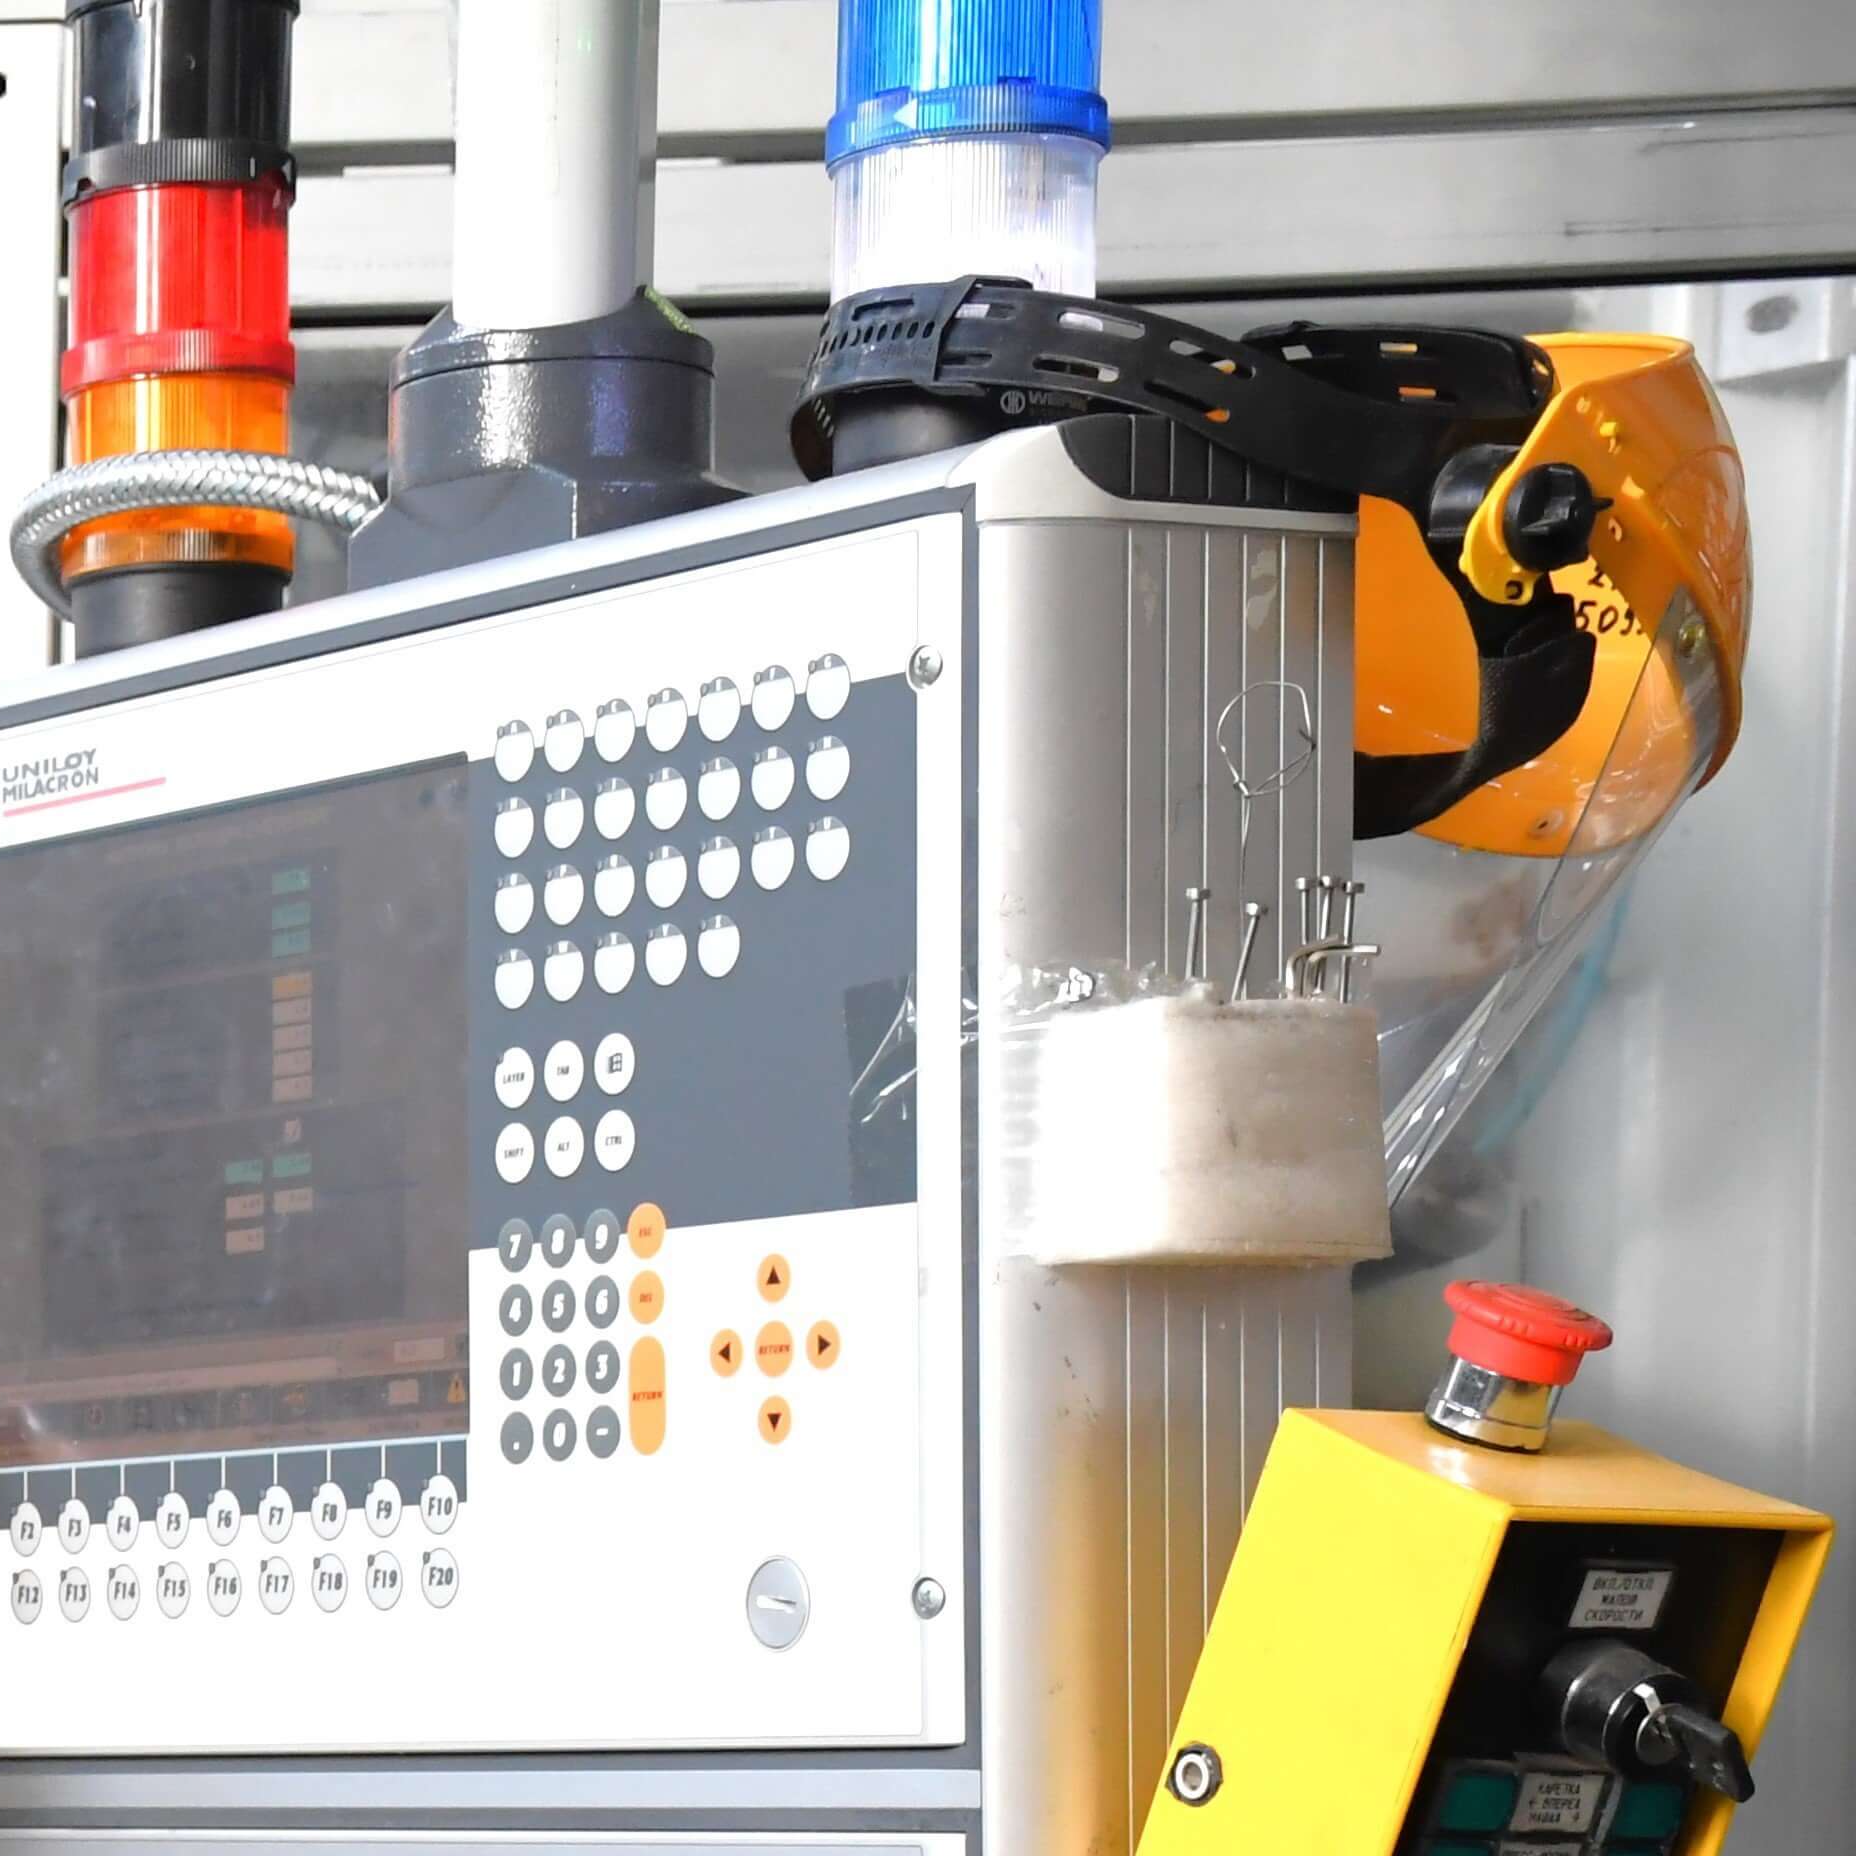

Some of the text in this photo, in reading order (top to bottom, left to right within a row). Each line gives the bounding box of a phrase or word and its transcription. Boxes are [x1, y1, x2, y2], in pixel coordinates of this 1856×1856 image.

[2, 748, 97, 783] UNILOY
[2, 766, 99, 803] MILACRON
[509, 1233, 522, 1259] 7
[551, 1228, 565, 1254] 8
[595, 1224, 608, 1249] 9
[508, 1298, 521, 1322] 4
[552, 1293, 565, 1319] 5
[595, 1289, 608, 1315] 6
[759, 1344, 791, 1355] RETURN
[513, 1361, 522, 1387] 1
[552, 1358, 566, 1383] 2
[595, 1354, 608, 1380] 3
[632, 1391, 663, 1402] RETURN
[553, 1422, 566, 1448] 0
[269, 1506, 284, 1526] F7
[322, 1503, 338, 1523] F8
[376, 1500, 392, 1520] F9
[428, 1496, 453, 1516] F10
[68, 1518, 82, 1538] F3
[117, 1515, 131, 1535] F4
[166, 1512, 181, 1532] F5
[217, 1510, 232, 1529] F6
[20, 1521, 34, 1540] F2
[214, 1576, 237, 1596] F16
[266, 1574, 289, 1593] F17
[319, 1571, 343, 1591] F18
[373, 1569, 398, 1589] F19
[428, 1566, 454, 1586] F20
[18, 1585, 39, 1604] F12
[66, 1583, 87, 1603] F13
[114, 1581, 136, 1600] F14
[164, 1579, 186, 1598] F15
